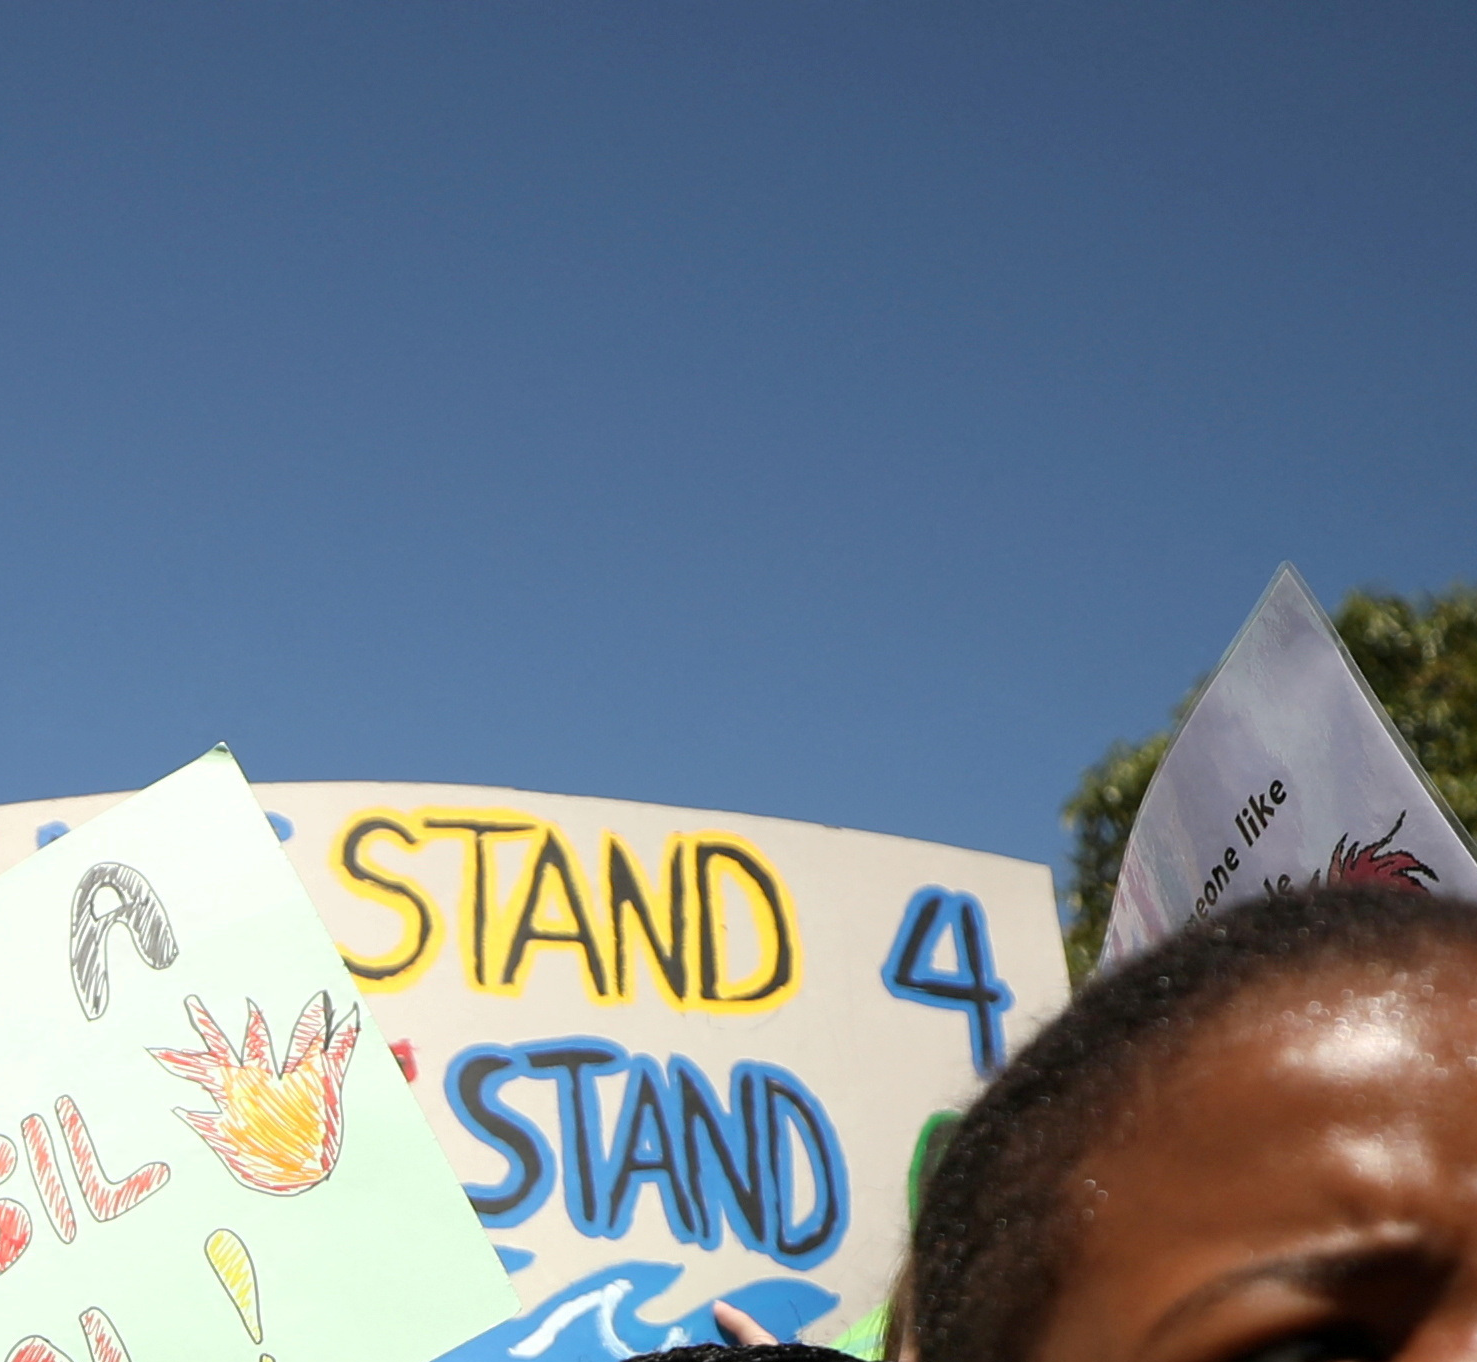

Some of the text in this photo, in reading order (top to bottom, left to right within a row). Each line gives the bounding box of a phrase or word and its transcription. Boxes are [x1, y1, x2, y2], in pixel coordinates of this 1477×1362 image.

[1234, 779, 1288, 848] like
[70, 861, 180, 1022] A
[329, 806, 1012, 1079] STAND 4
[445, 1036, 849, 1270] STAND
